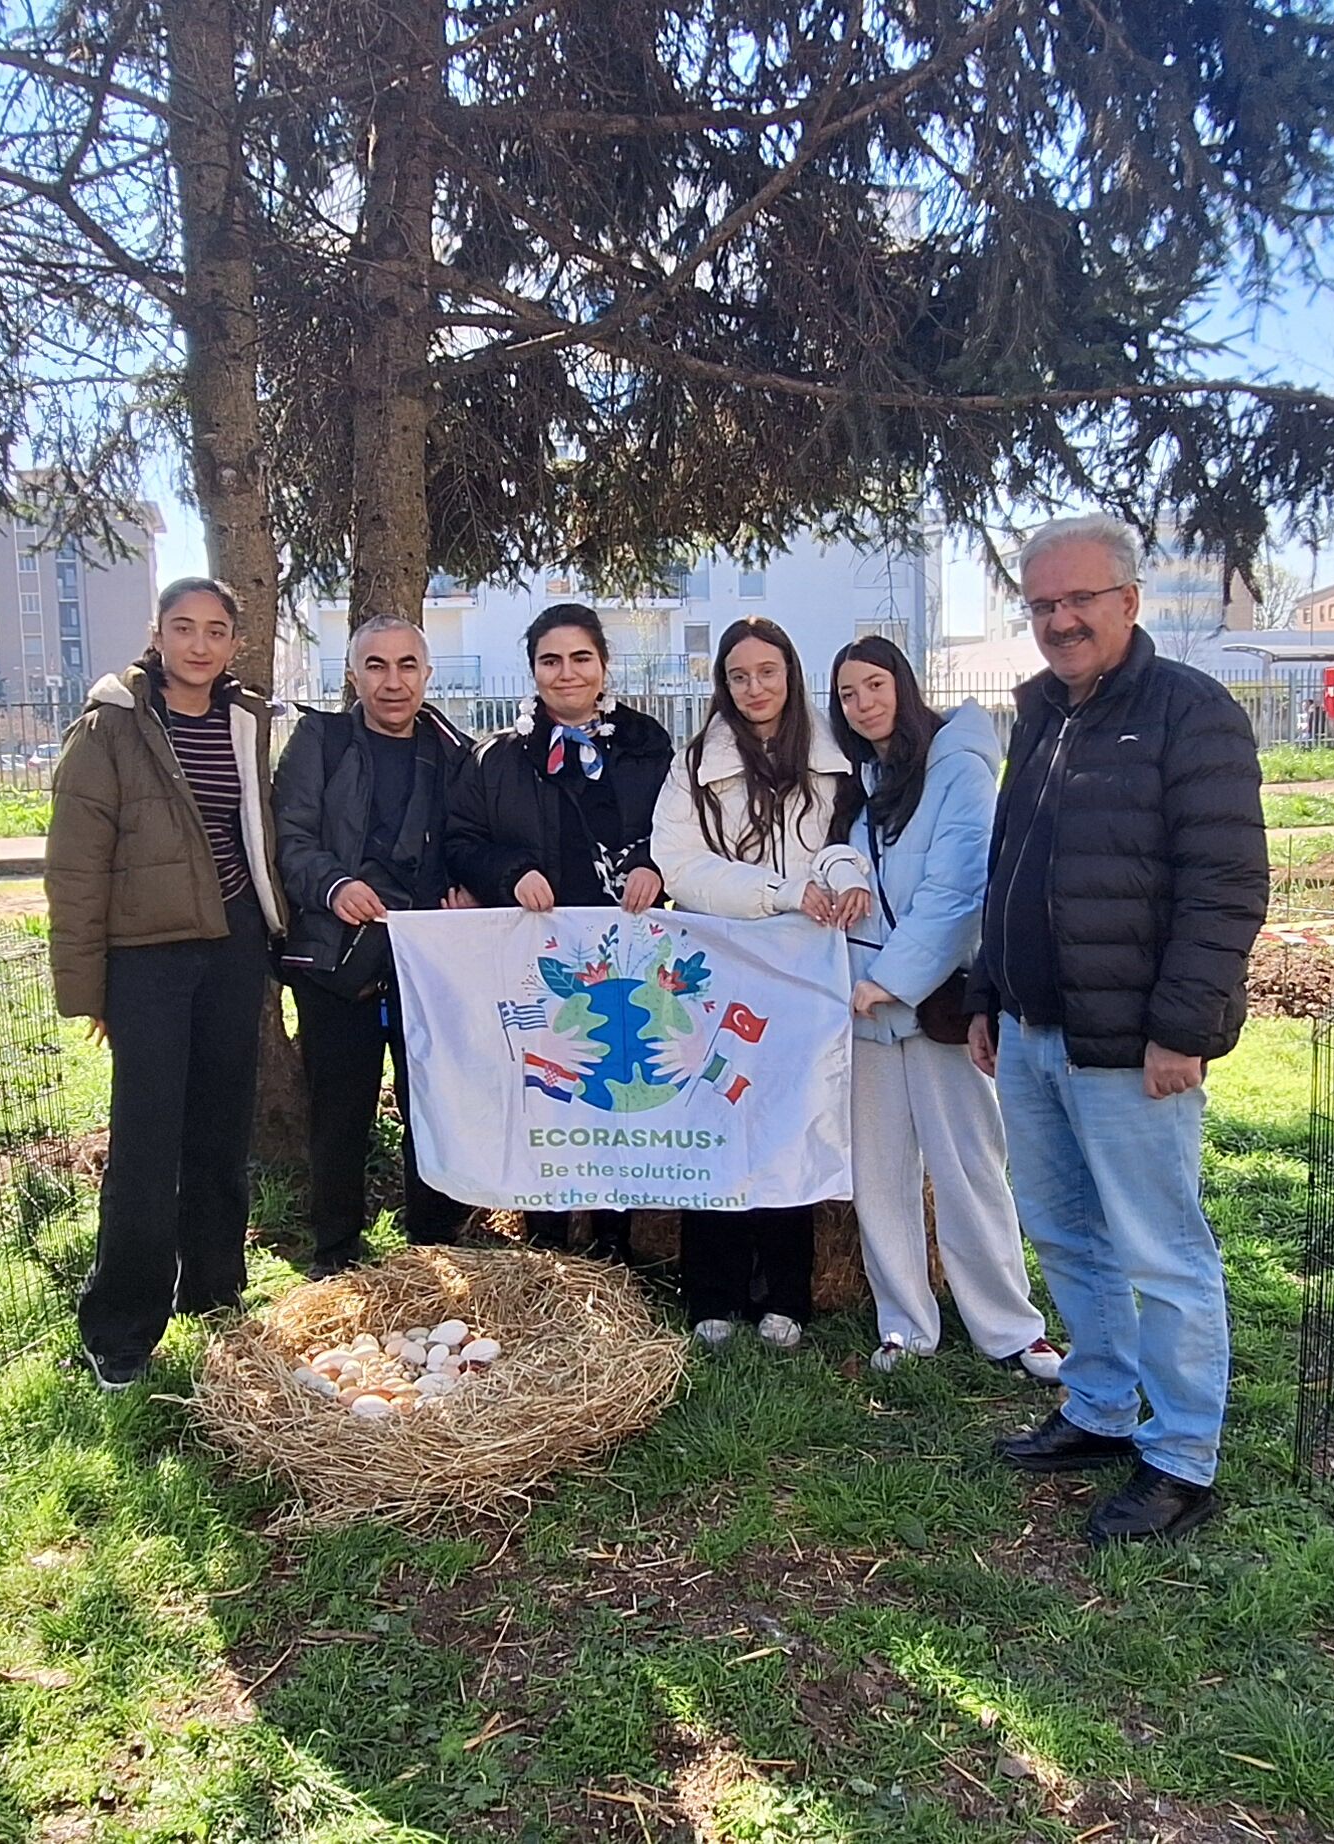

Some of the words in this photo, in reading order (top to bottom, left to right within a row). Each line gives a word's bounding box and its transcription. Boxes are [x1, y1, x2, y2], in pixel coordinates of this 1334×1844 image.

[528, 1127, 727, 1150] ECORASMUS+
[539, 1162, 569, 1179] Be
[575, 1161, 615, 1178] the
[619, 1163, 711, 1182] solution
[513, 1191, 553, 1206] not
[558, 1188, 598, 1205] the
[604, 1188, 747, 1209] destruction!
